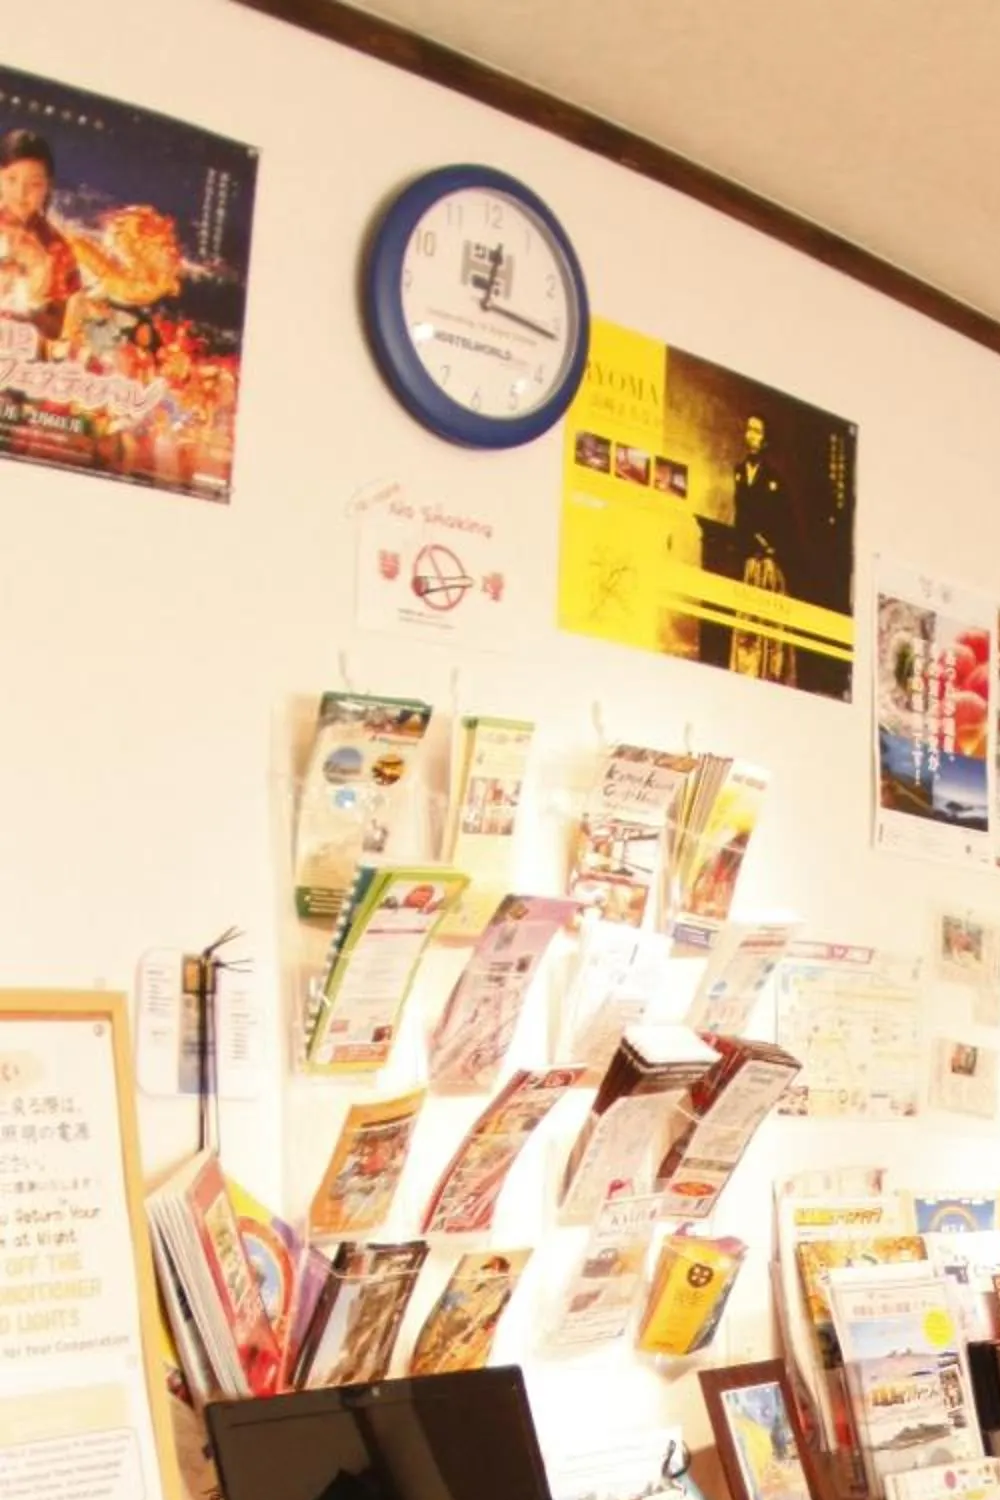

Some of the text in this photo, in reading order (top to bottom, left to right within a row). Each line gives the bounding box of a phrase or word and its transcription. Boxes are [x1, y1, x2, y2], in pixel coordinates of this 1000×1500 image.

[446, 201, 464, 231] 11
[483, 201, 503, 230] 12
[415, 228, 436, 257] 10
[586, 357, 661, 407] YOMA
[69, 1204, 102, 1220] Your
[14, 1228, 78, 1248] at Night
[17, 1308, 81, 1335] LIGHTS
